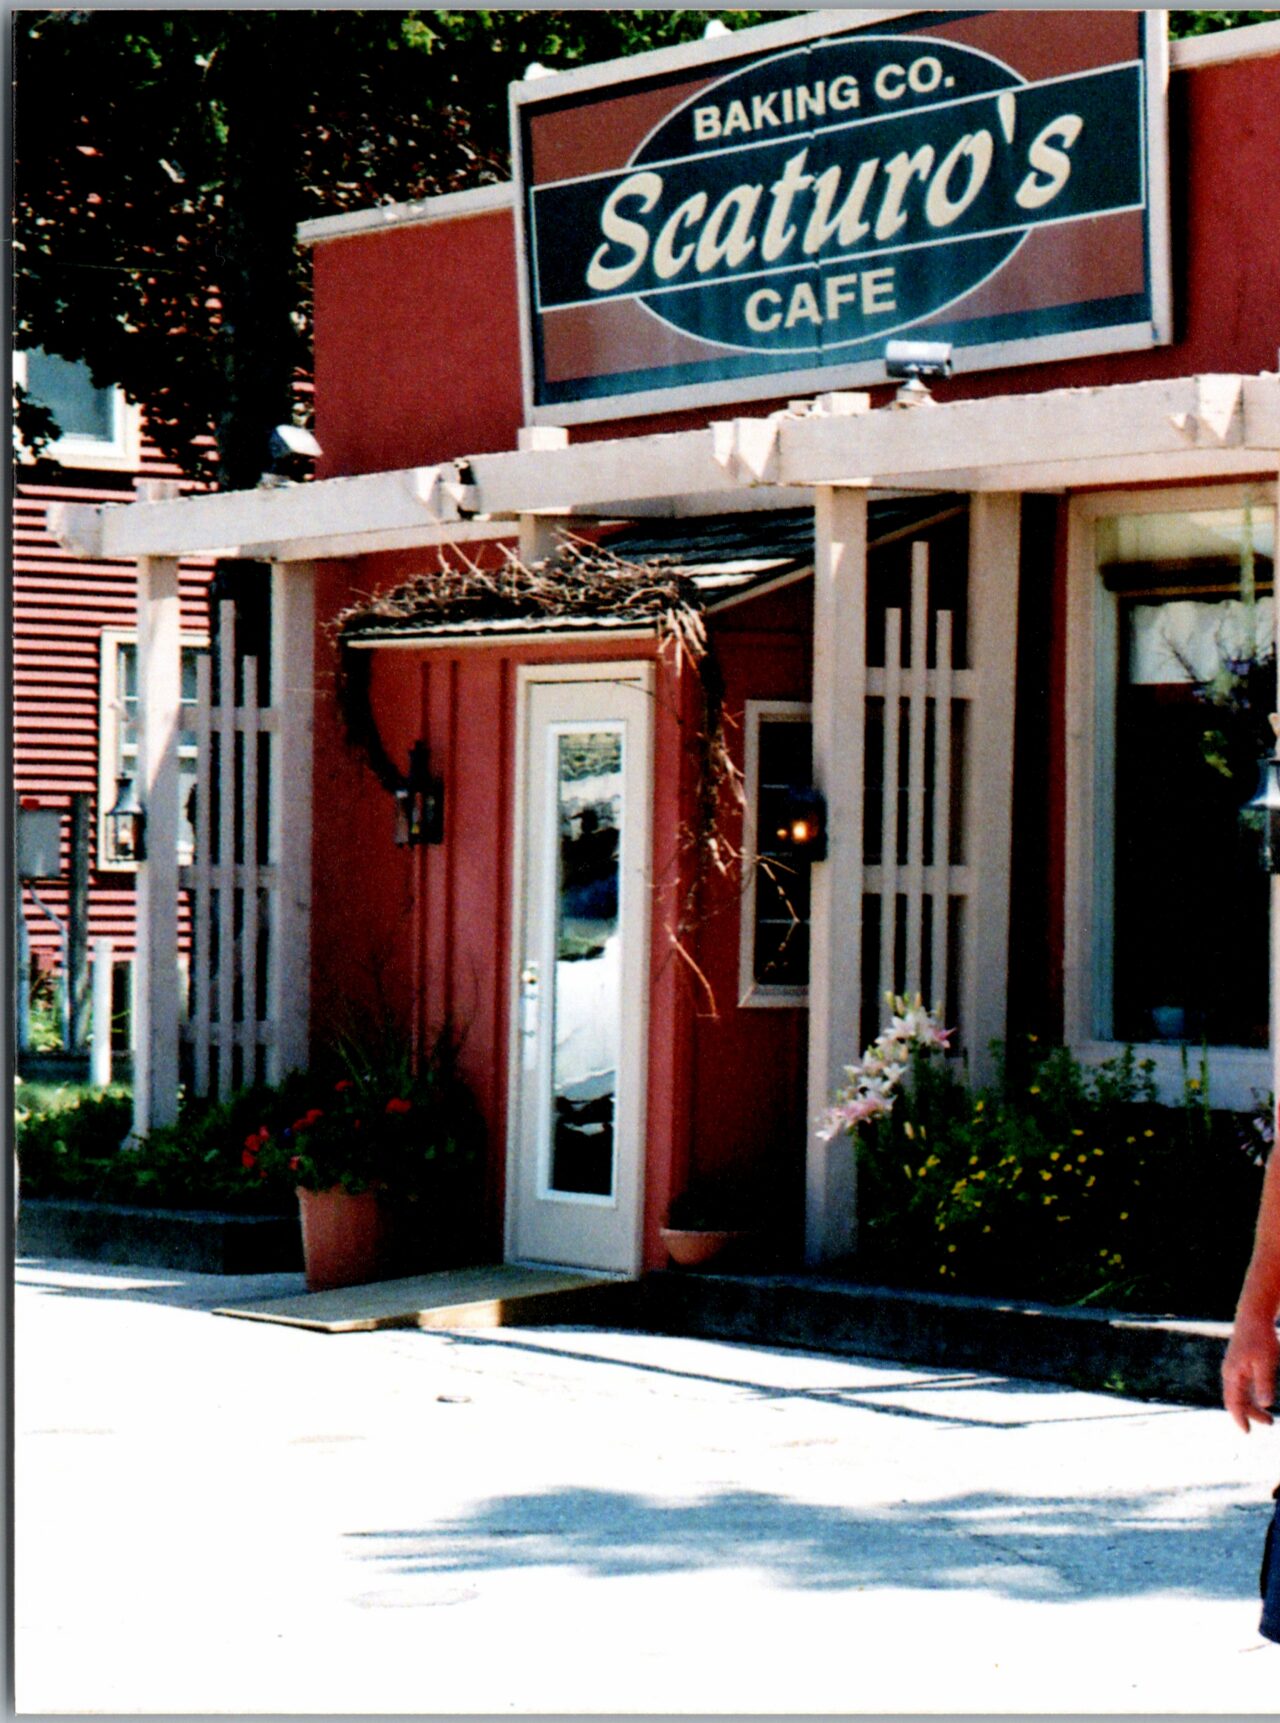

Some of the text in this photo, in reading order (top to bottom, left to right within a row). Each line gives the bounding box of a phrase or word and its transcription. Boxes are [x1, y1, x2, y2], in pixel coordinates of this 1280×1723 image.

[693, 56, 956, 142] BAKING CO.
[586, 91, 1084, 291] Scaturo's
[744, 267, 896, 333] CAFE
